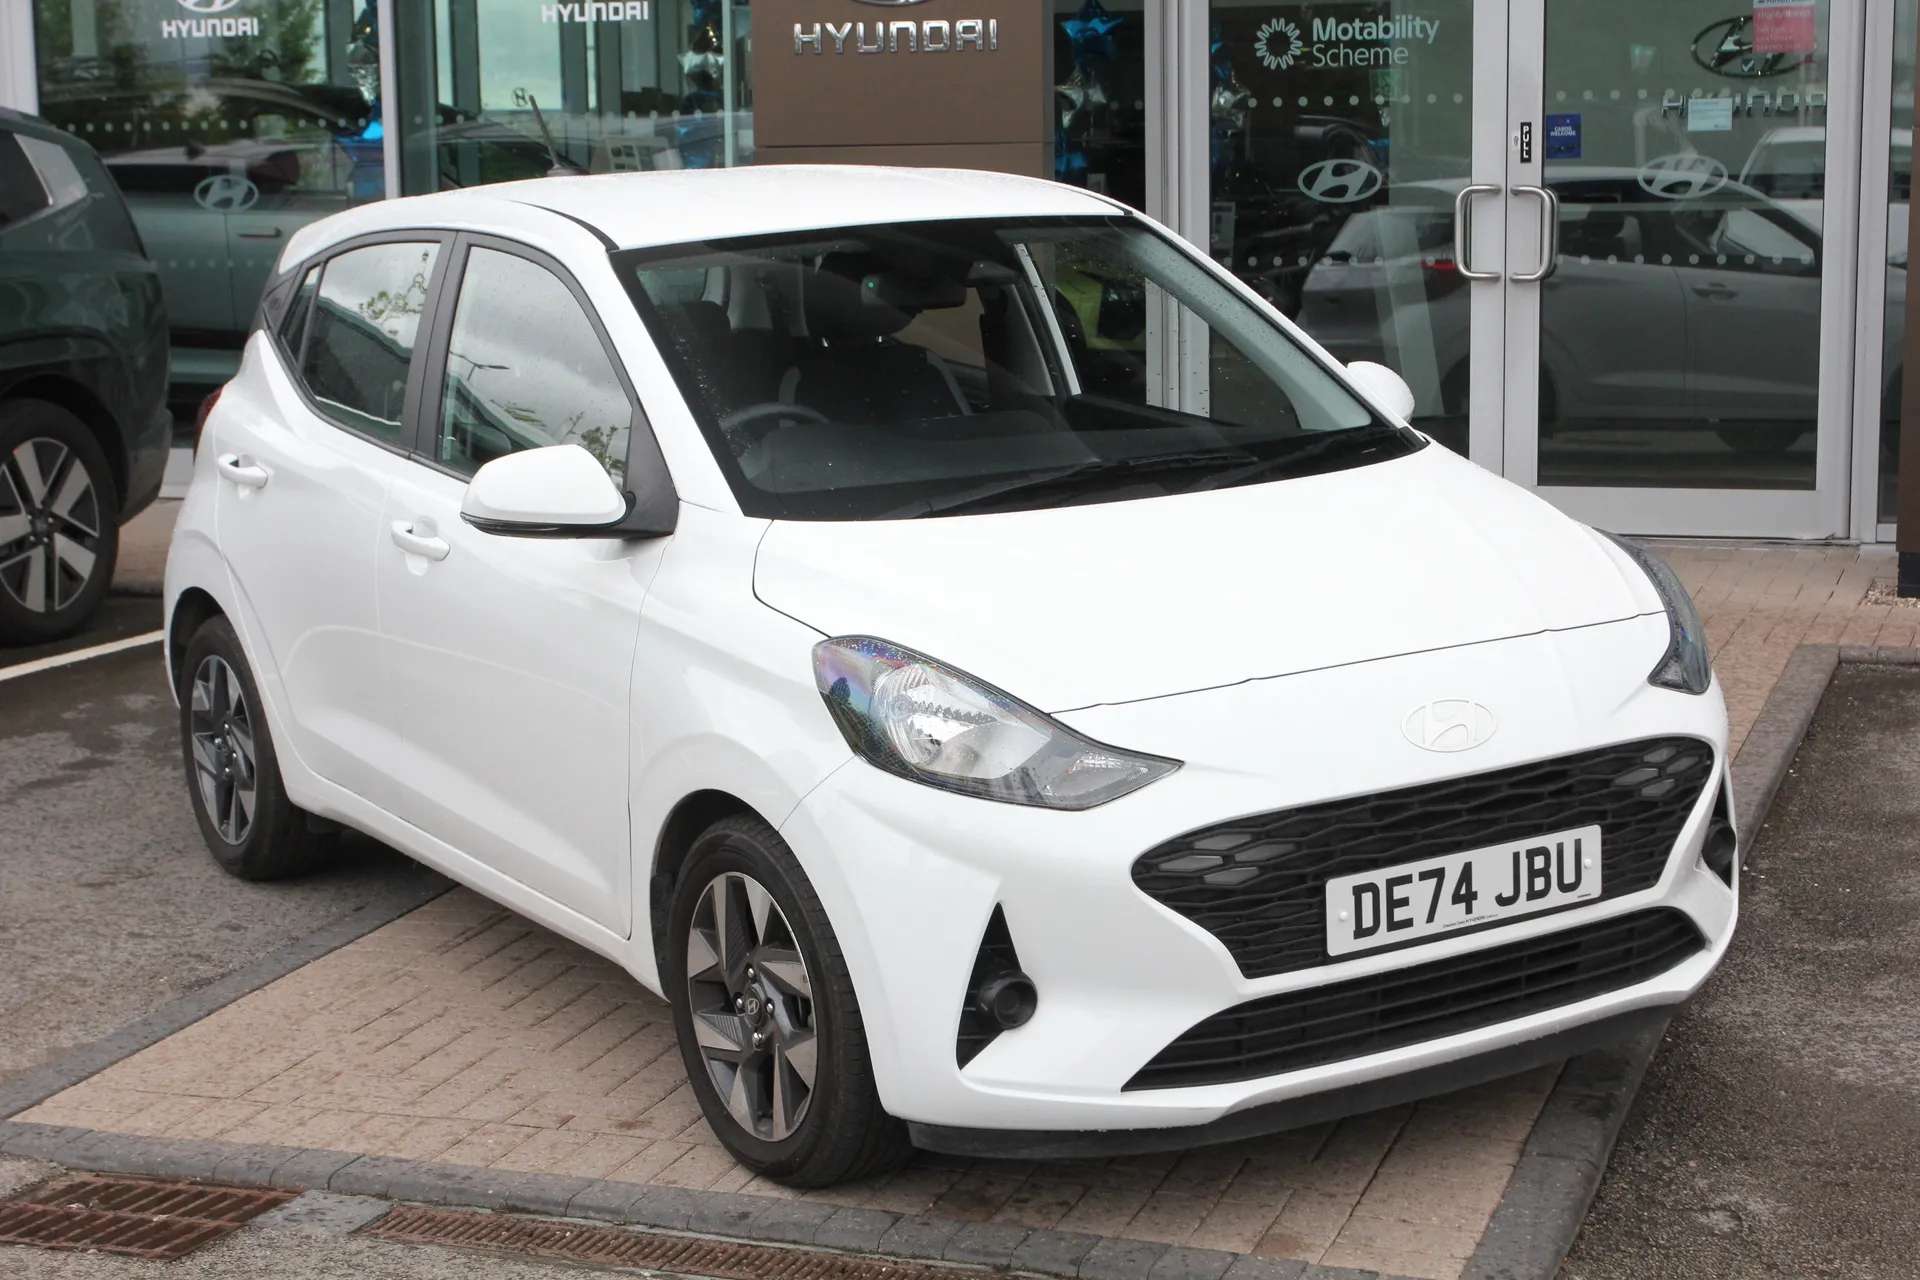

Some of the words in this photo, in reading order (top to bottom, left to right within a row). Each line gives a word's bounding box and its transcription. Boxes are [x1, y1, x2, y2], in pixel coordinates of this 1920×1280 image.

[541, 1, 649, 23] HYUNDAI
[162, 17, 259, 38] HYUNDAI
[793, 19, 998, 55] HYUNDAI
[1312, 15, 1440, 44] Motability
[1312, 43, 1409, 67] Scheme
[1352, 861, 1478, 939] DE74
[1495, 838, 1582, 907] JBU
